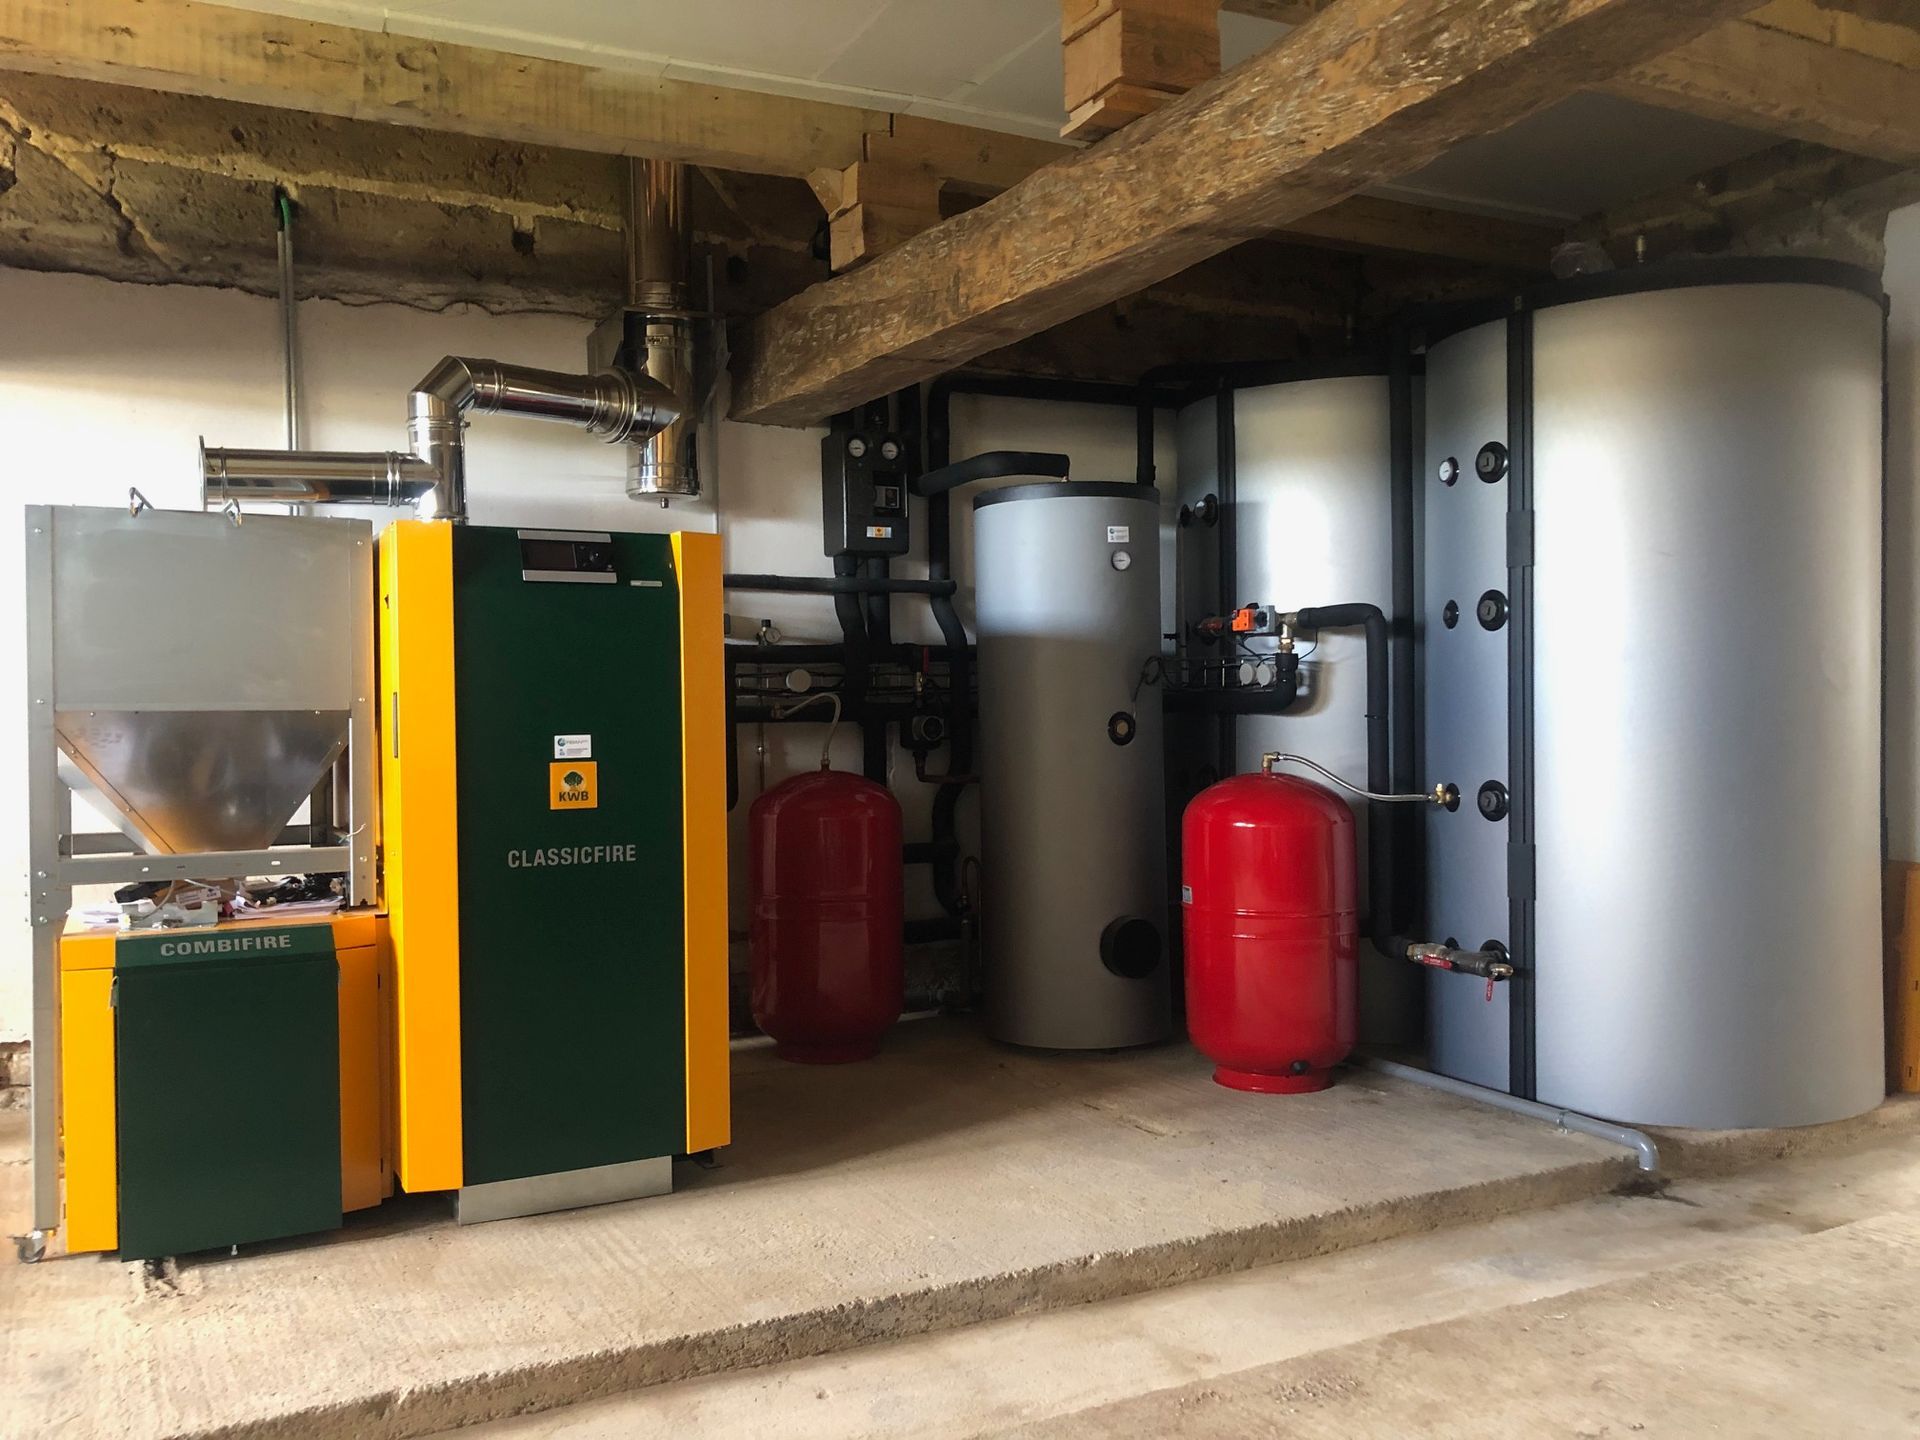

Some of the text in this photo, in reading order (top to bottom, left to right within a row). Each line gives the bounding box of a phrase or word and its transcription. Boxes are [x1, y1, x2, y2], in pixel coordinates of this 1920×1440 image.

[559, 791, 589, 802] KWB
[507, 844, 637, 868] CLASSICFIRE
[160, 934, 291, 957] COMBIFIRE
